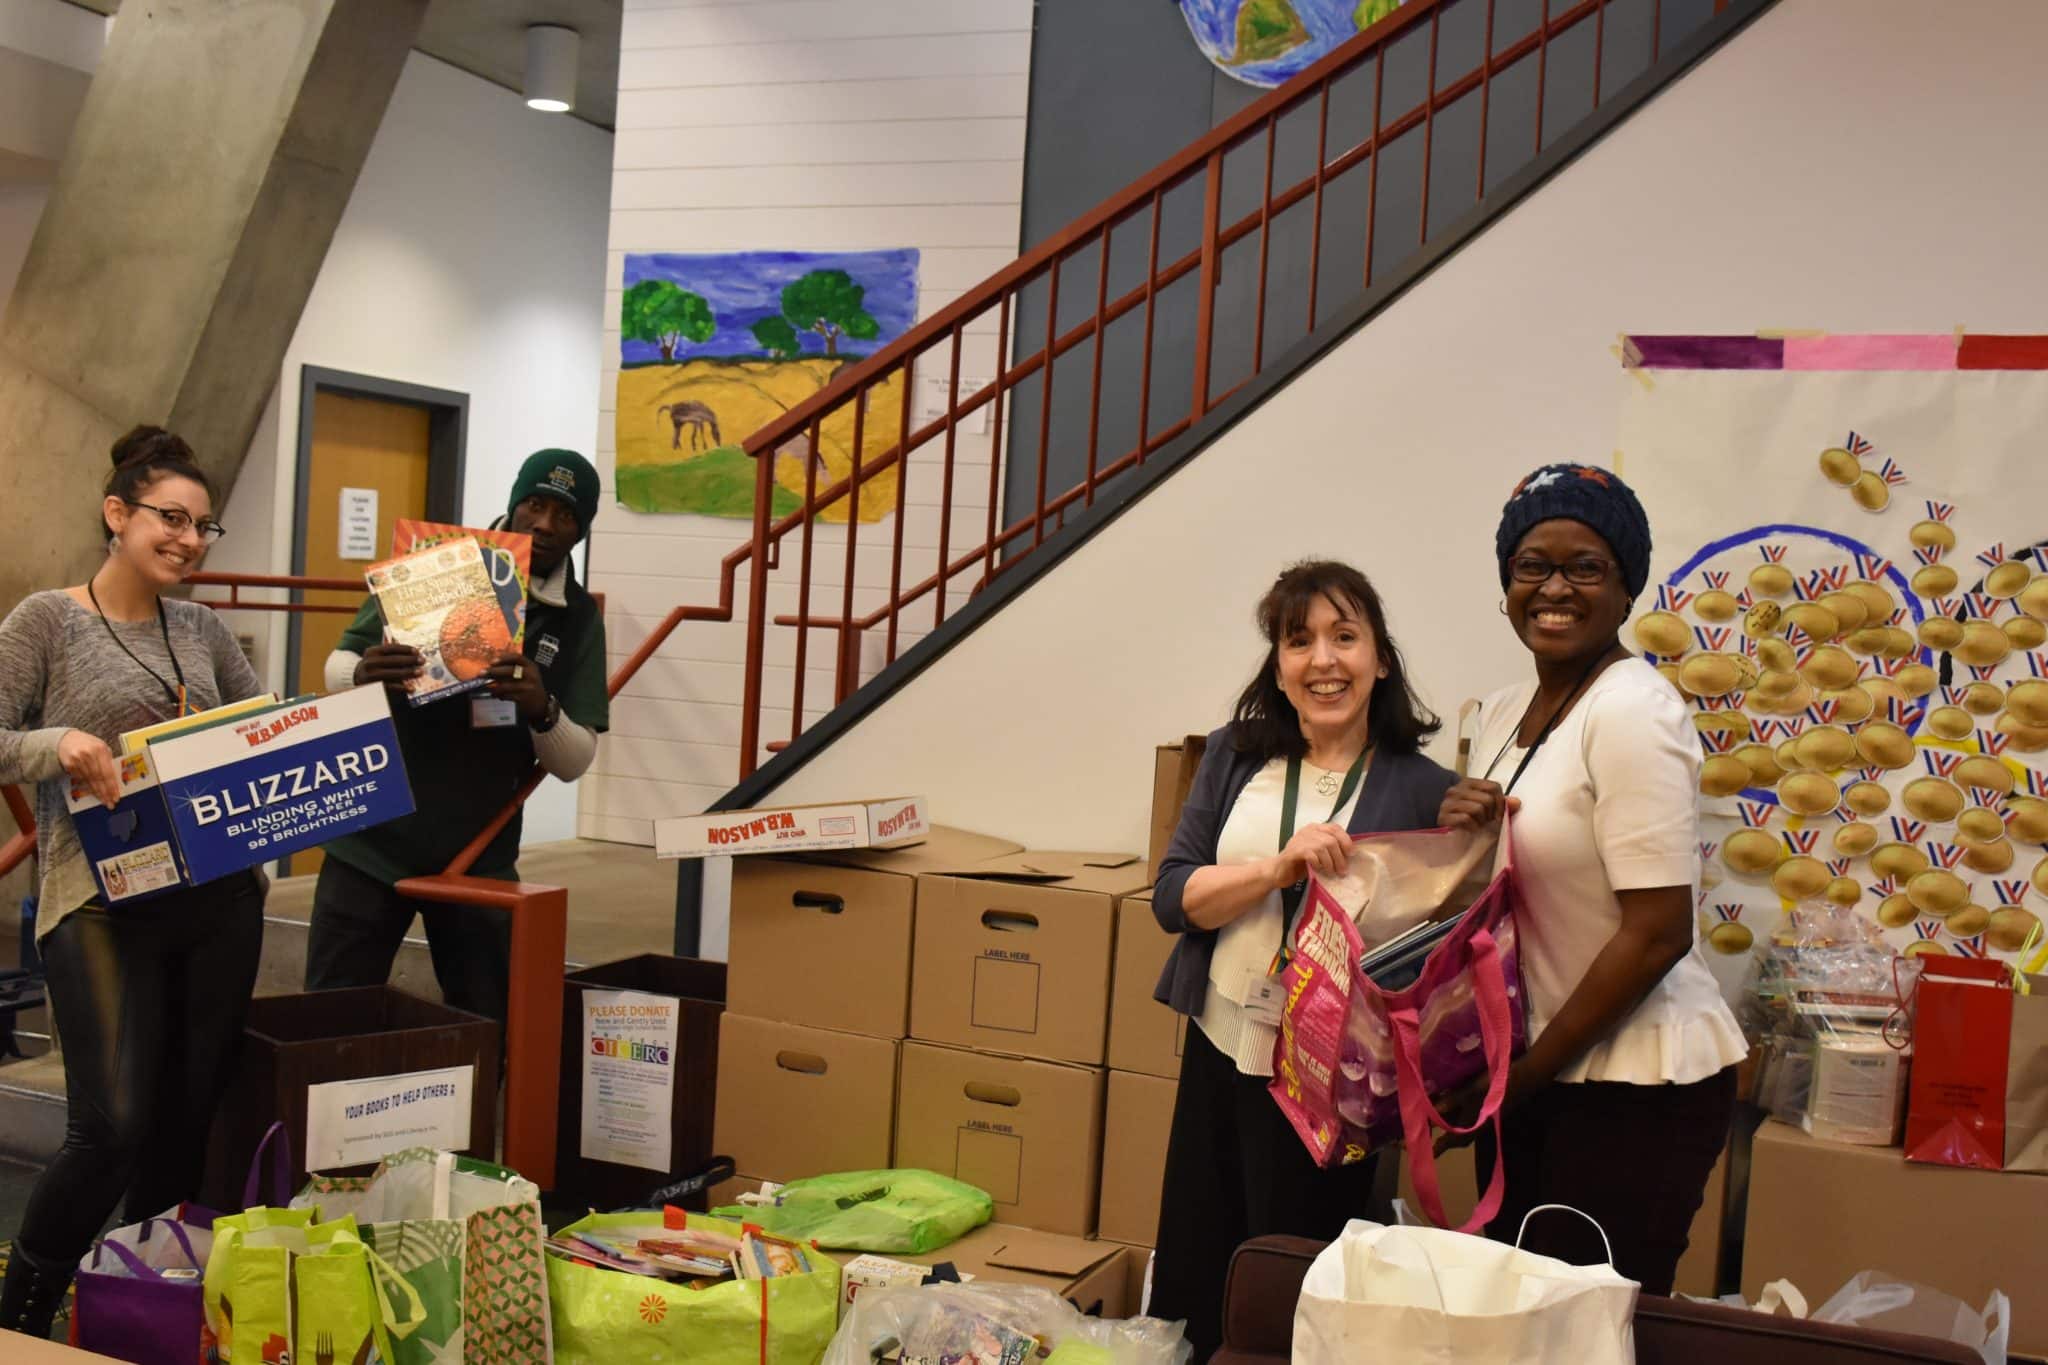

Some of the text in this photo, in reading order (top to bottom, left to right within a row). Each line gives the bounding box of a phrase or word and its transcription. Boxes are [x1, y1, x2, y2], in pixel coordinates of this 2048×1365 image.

[191, 743, 390, 827] BLIZZARD
[226, 780, 378, 838] BLINDING WHITE
[258, 799, 354, 835] COPY PAPER
[248, 804, 369, 850] 98 BRIGHTNESS
[776, 830, 789, 840] BUT
[983, 948, 1030, 961] LABEL HERE
[590, 1005, 671, 1017] PLEASE DONATE
[345, 1104, 364, 1119] YOUR
[366, 1097, 390, 1116] BOOKS
[392, 1094, 401, 1107] TO
[403, 1088, 421, 1104] HELP
[422, 1084, 449, 1100] OTHERS
[967, 1119, 1013, 1133] LABEL HERE
